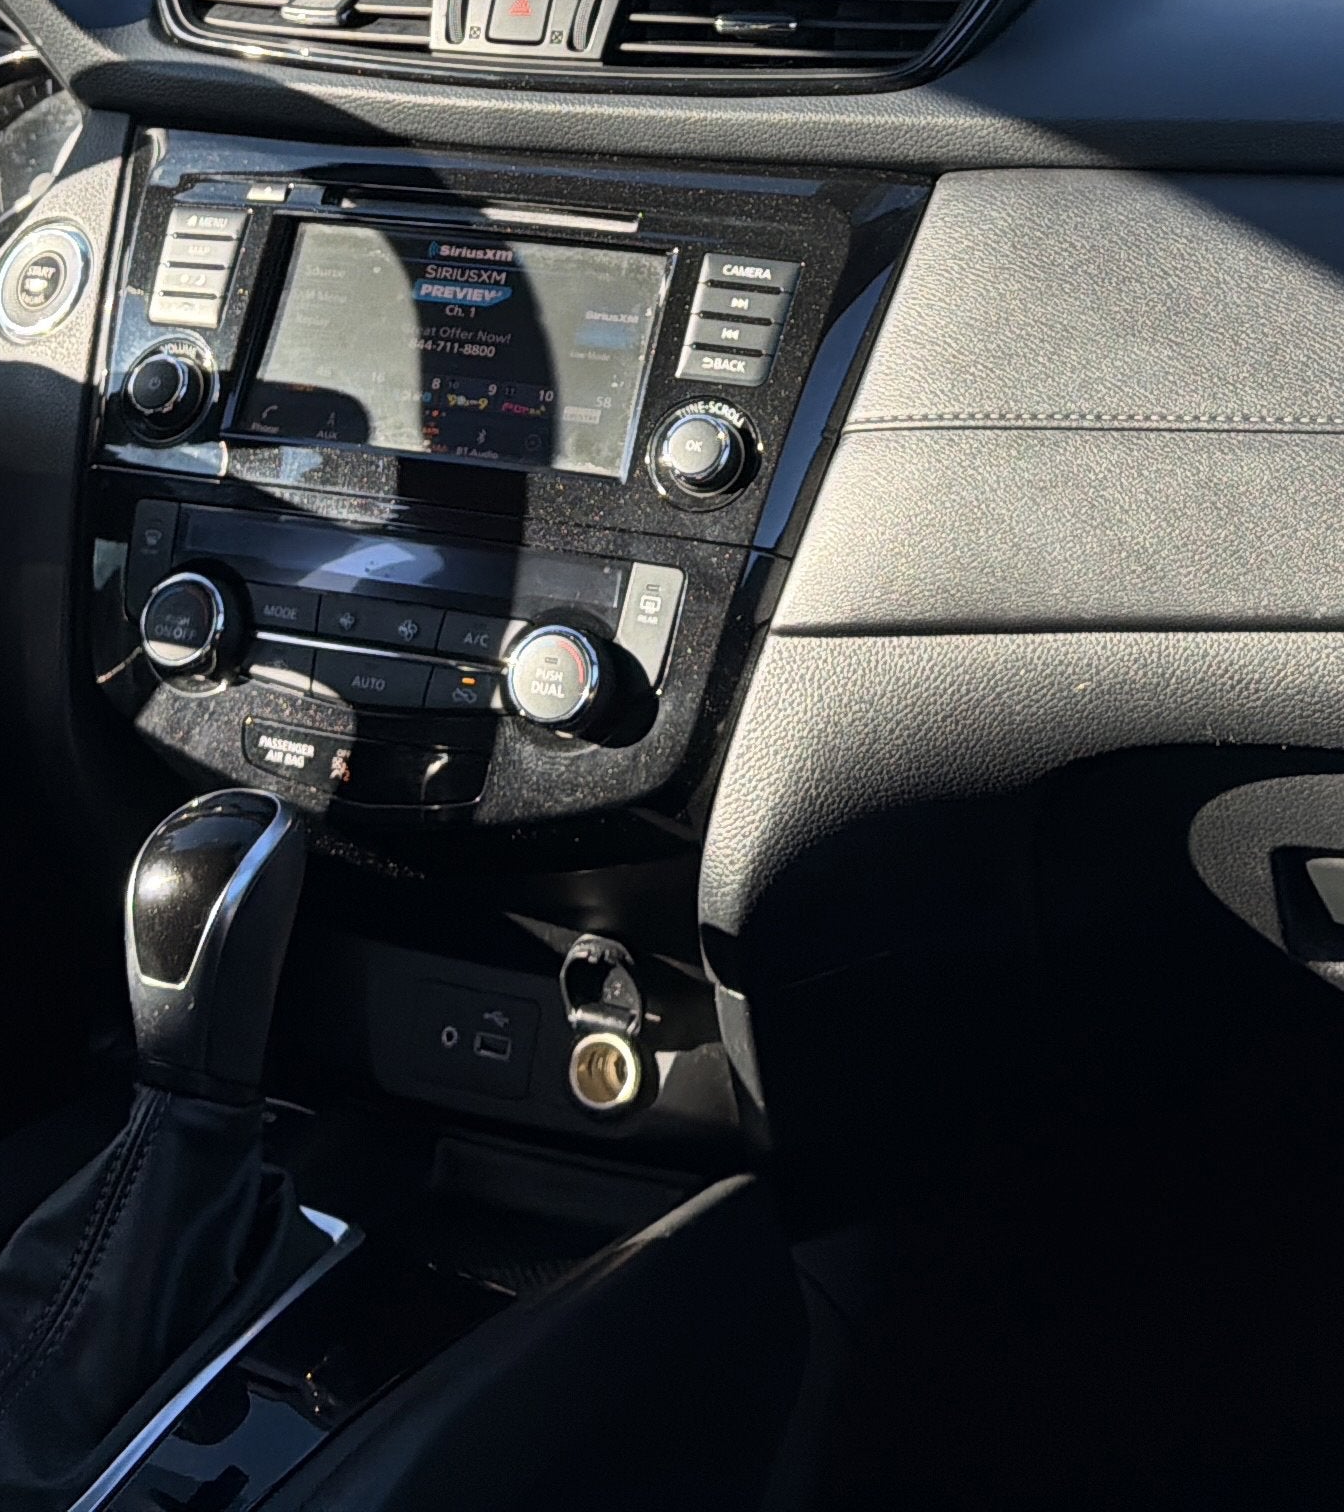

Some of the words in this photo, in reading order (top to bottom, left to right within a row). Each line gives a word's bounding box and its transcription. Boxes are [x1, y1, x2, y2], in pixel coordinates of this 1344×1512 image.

[722, 263, 772, 281] CAMERA
[419, 283, 504, 302] PREVIEW
[468, 306, 476, 318] 1
[439, 326, 474, 341] Offer
[477, 330, 513, 344] Now!
[713, 356, 746, 374] BACK
[431, 377, 441, 390] 8
[487, 384, 498, 397] 9
[538, 389, 554, 403] 10
[595, 396, 612, 409] 58
[685, 439, 703, 453] OK
[263, 604, 298, 620] MODE
[463, 632, 489, 648] A/C
[350, 674, 387, 692] AUTO
[535, 669, 564, 682] PUSH
[530, 682, 566, 700] DUAL
[258, 734, 316, 759] PASSENGER
[264, 749, 284, 764] AIR
[283, 753, 305, 769] BAG
